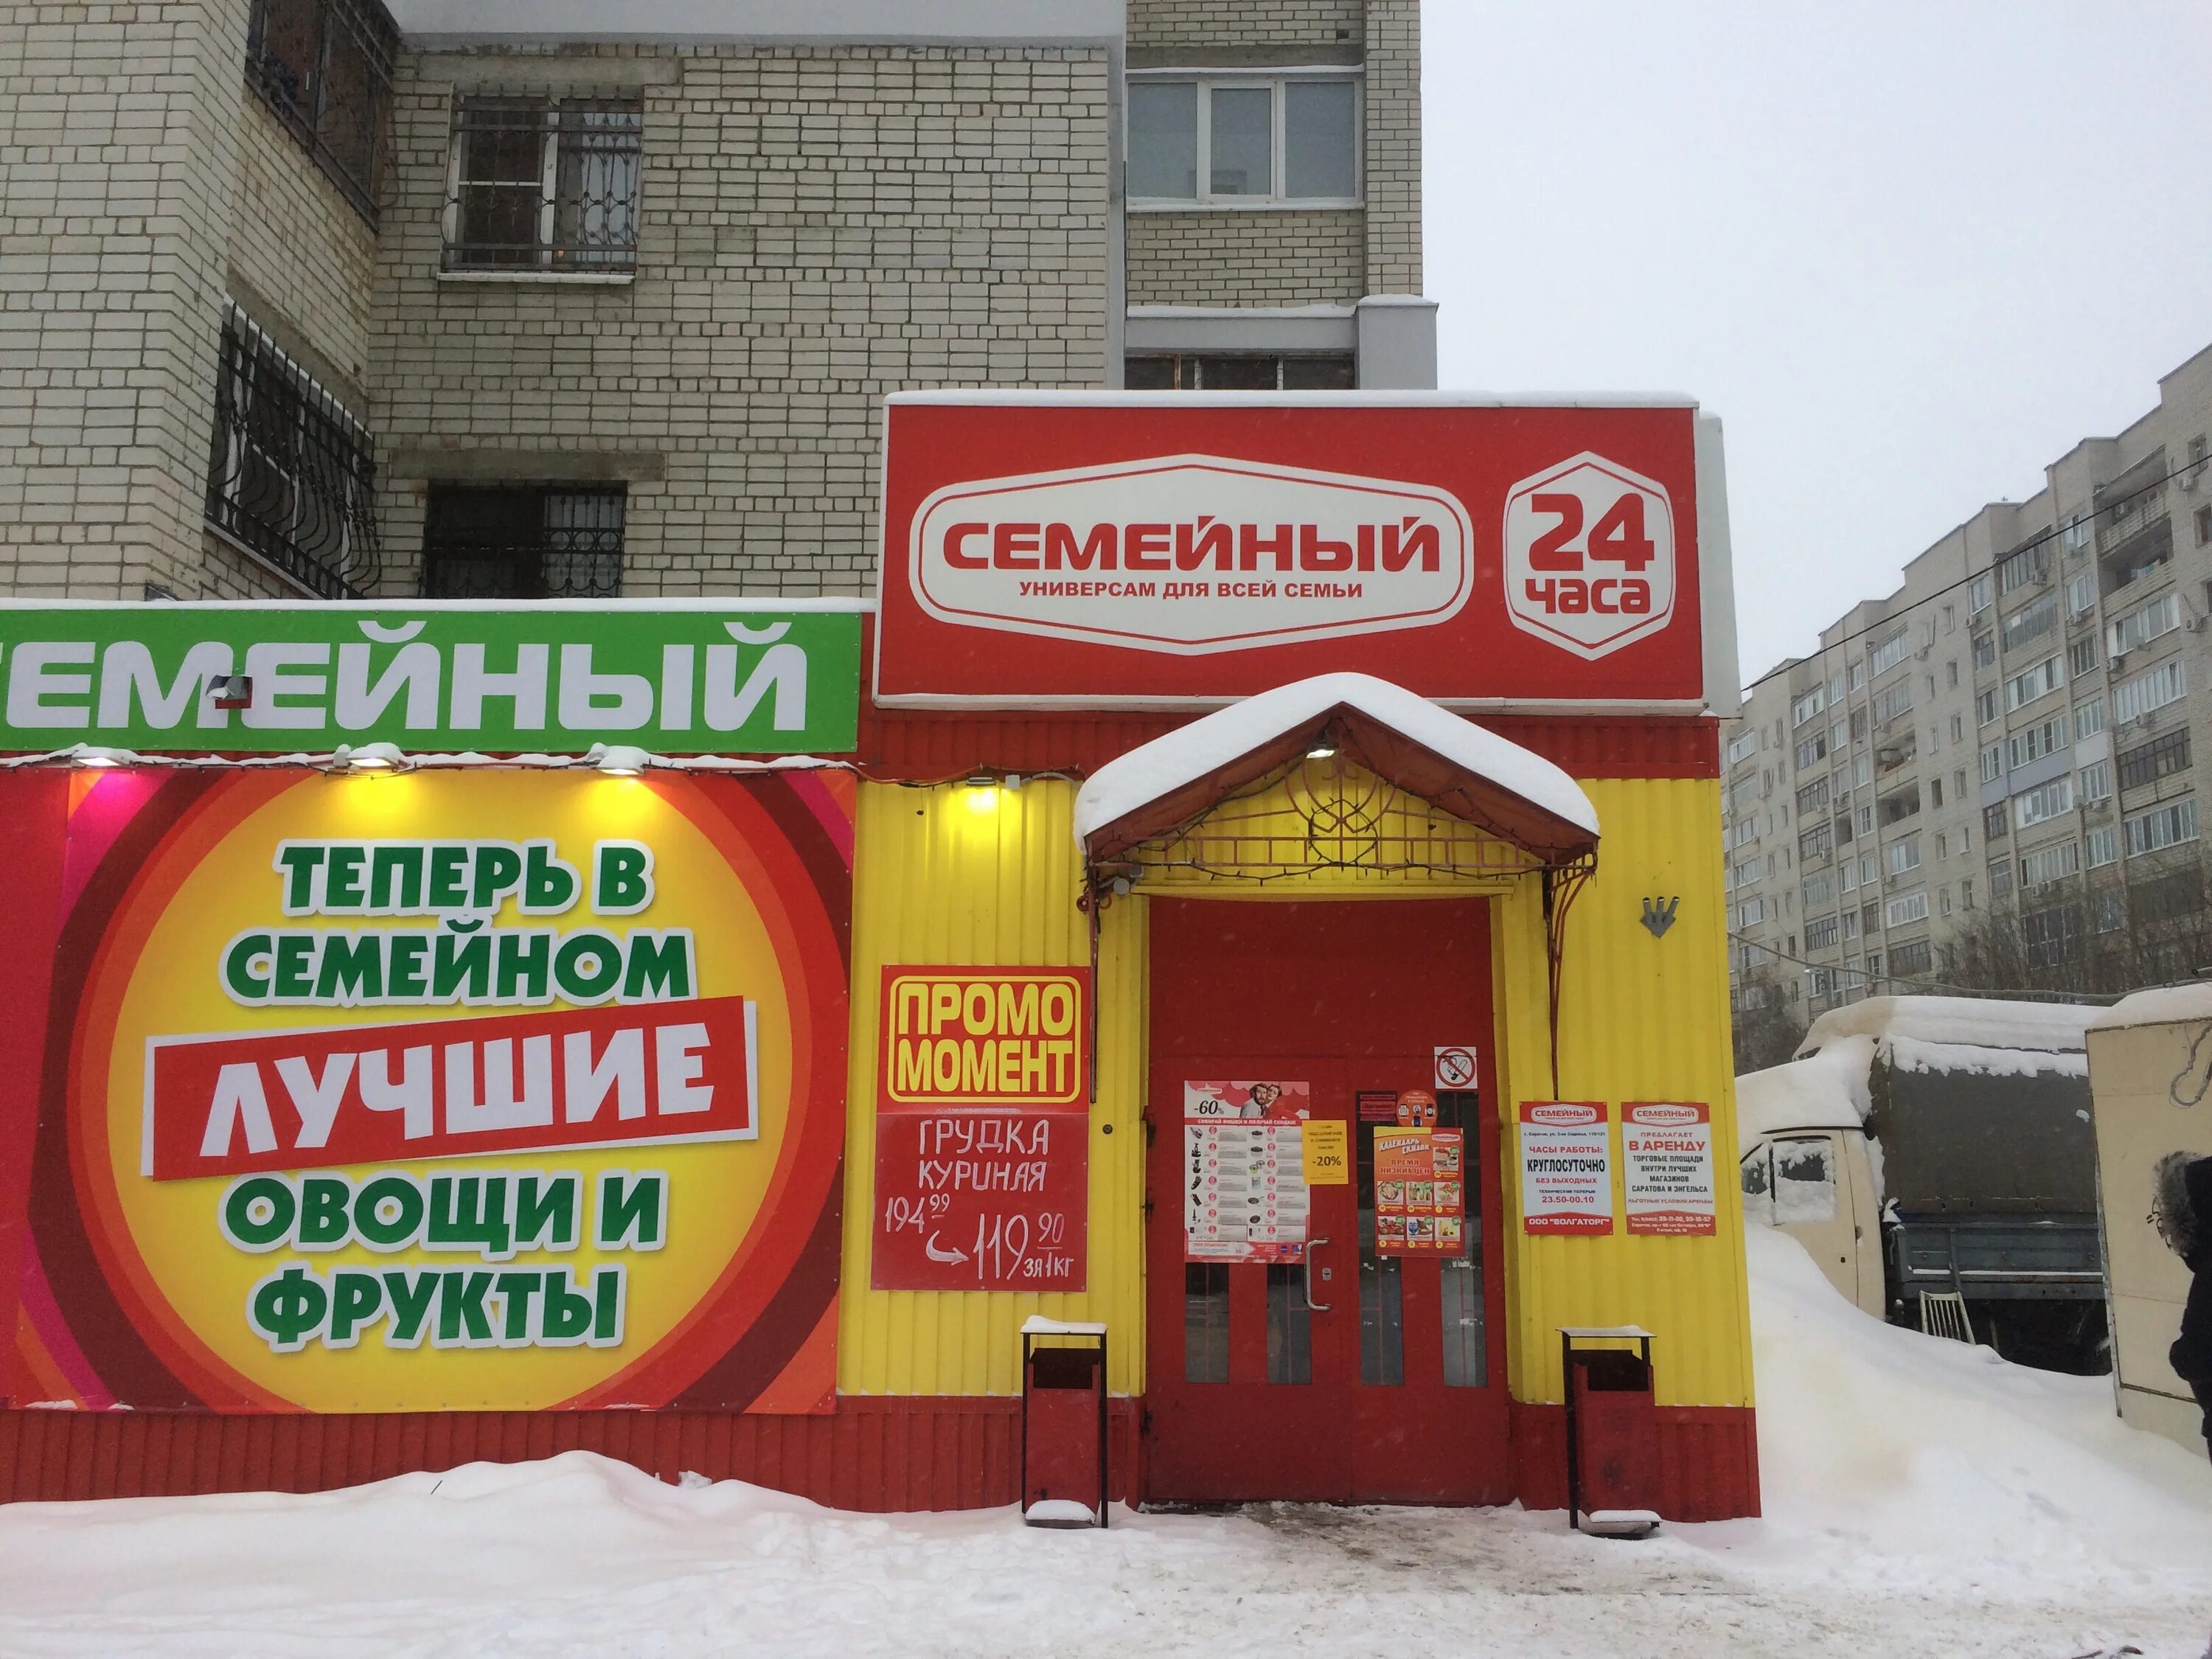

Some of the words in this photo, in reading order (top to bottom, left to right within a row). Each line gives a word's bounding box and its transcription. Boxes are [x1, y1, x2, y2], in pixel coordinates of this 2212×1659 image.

[942, 515, 1441, 572] СЕМЕЙНЫЙ
[1529, 493, 1655, 571] 24
[1019, 581, 1156, 598] УНИВЕРСАМ
[1163, 582, 1210, 600] ДЛЯ
[1217, 578, 1279, 598] ВСЕЙ
[1284, 582, 1363, 598] СЕМЬИ
[0, 620, 808, 731] ЕМЕЙНЫЙ
[279, 846, 574, 910] ТЕПЕРЬ
[599, 846, 647, 909] В
[226, 917, 691, 999] СЕМЕЙНОМ
[898, 983, 1074, 1036] ПРОМО
[897, 1038, 1074, 1093] МОМЕНТ
[198, 1023, 716, 1158] ЛУЧШИЕ
[1534, 1109, 1593, 1117] СЕМЕЙНЫЙ
[1636, 1109, 1695, 1117] СЕМЕЙНЫЙ
[918, 1119, 1050, 1155] ГРУДКА
[1379, 1138, 1420, 1151] КАЛЕНДАРЬ
[1402, 1144, 1430, 1155] СКИДОК
[1628, 1141, 1639, 1151] В
[1642, 1140, 1706, 1152] АРЕНДУ
[918, 1160, 1048, 1192] КУРИНАЯ
[1312, 1155, 1342, 1166] -20%
[1413, 1167, 1430, 1176] ЦЕН
[1527, 1159, 1605, 1172] КРУГЛОСУТОЧНО
[225, 1176, 574, 1253] ОВОЩИ
[602, 1177, 661, 1243] И
[885, 1197, 925, 1234] 194
[973, 1213, 1029, 1281] 119
[1038, 1212, 1065, 1244] 90
[254, 1268, 619, 1343] ФРУКТЫ
